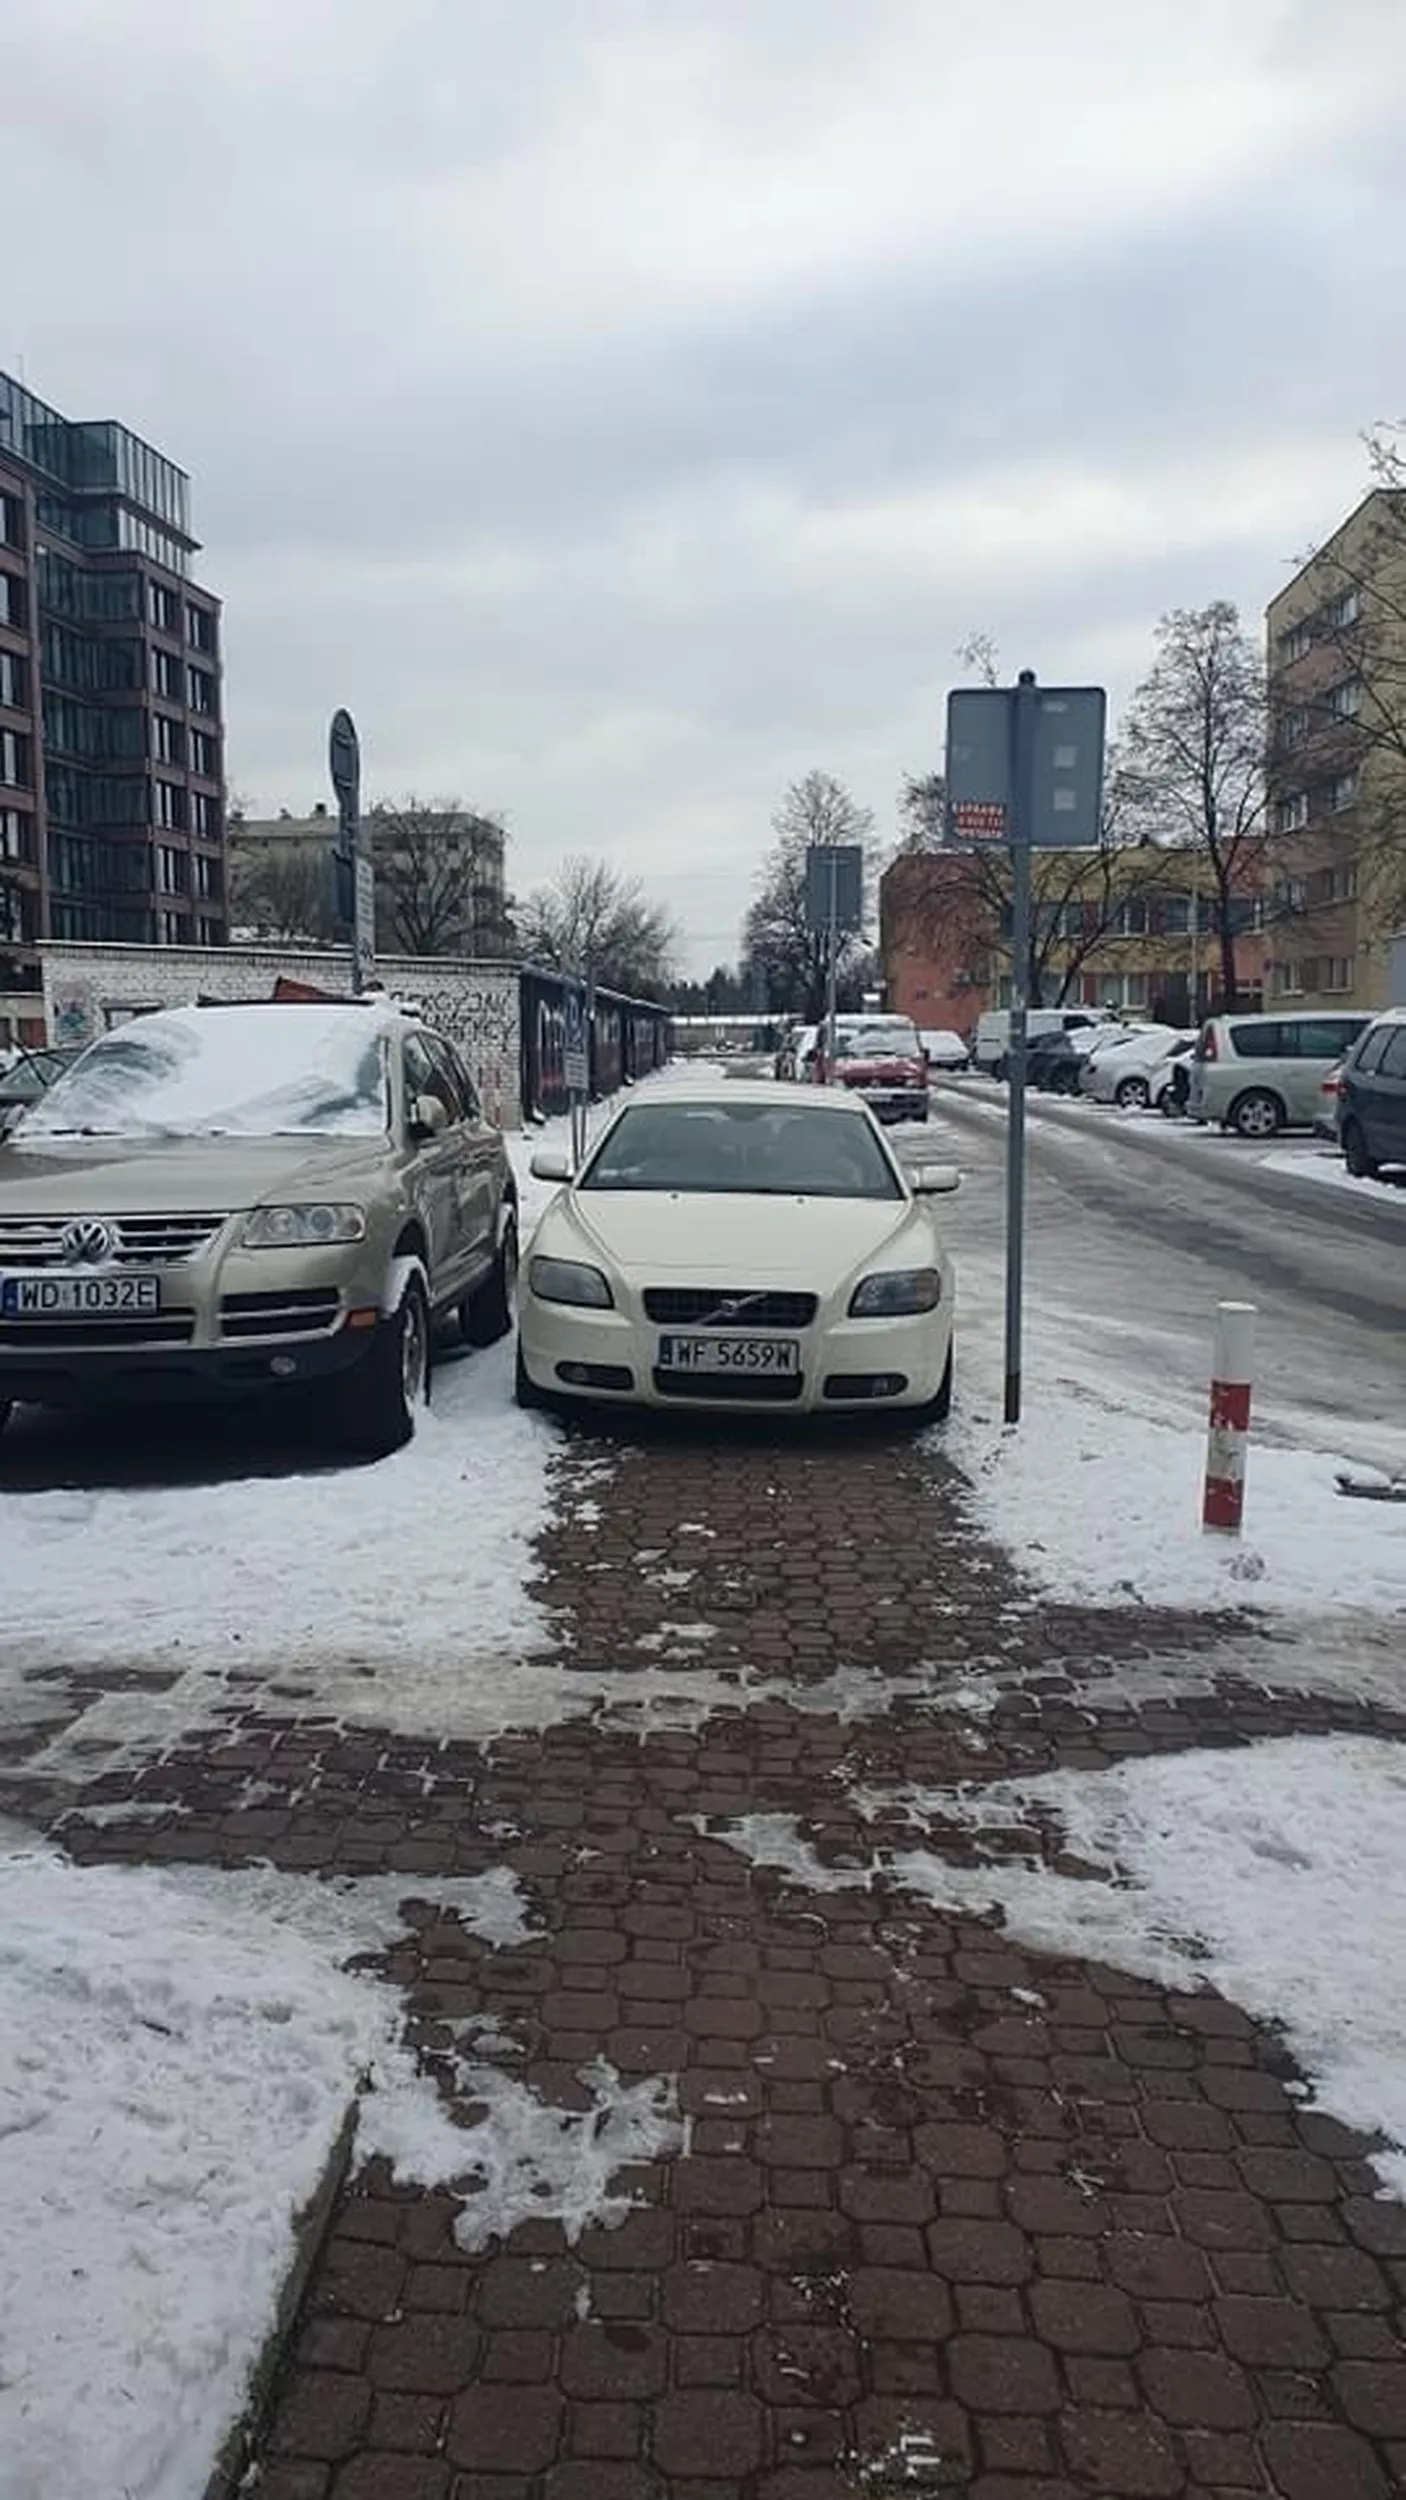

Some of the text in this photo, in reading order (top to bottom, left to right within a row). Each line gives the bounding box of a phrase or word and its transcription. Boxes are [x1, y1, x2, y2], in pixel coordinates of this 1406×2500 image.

[21, 1281, 153, 1308] WD 1032E
[677, 1342, 791, 1369] WF 5659W
